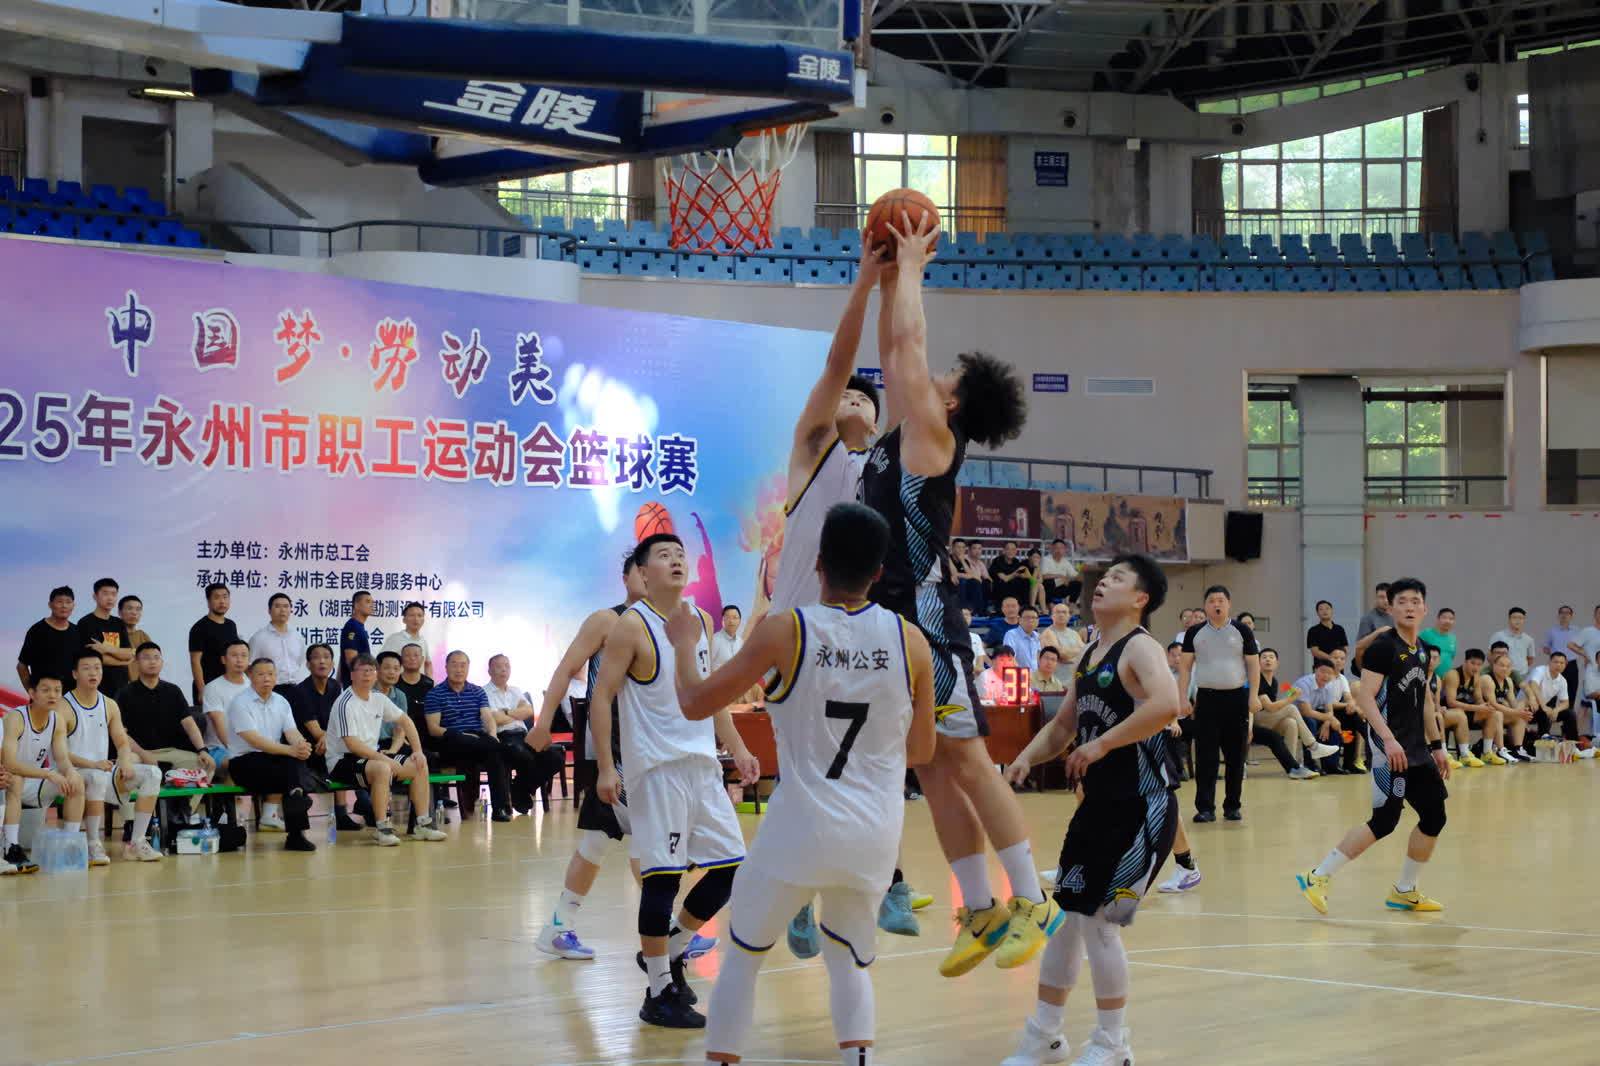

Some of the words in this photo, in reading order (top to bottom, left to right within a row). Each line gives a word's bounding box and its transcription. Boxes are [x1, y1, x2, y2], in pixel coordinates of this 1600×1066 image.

[788, 54, 849, 84] 金陵
[423, 80, 621, 144] 金陵
[816, 645, 889, 670] 永州公安
[825, 700, 870, 779] 7
